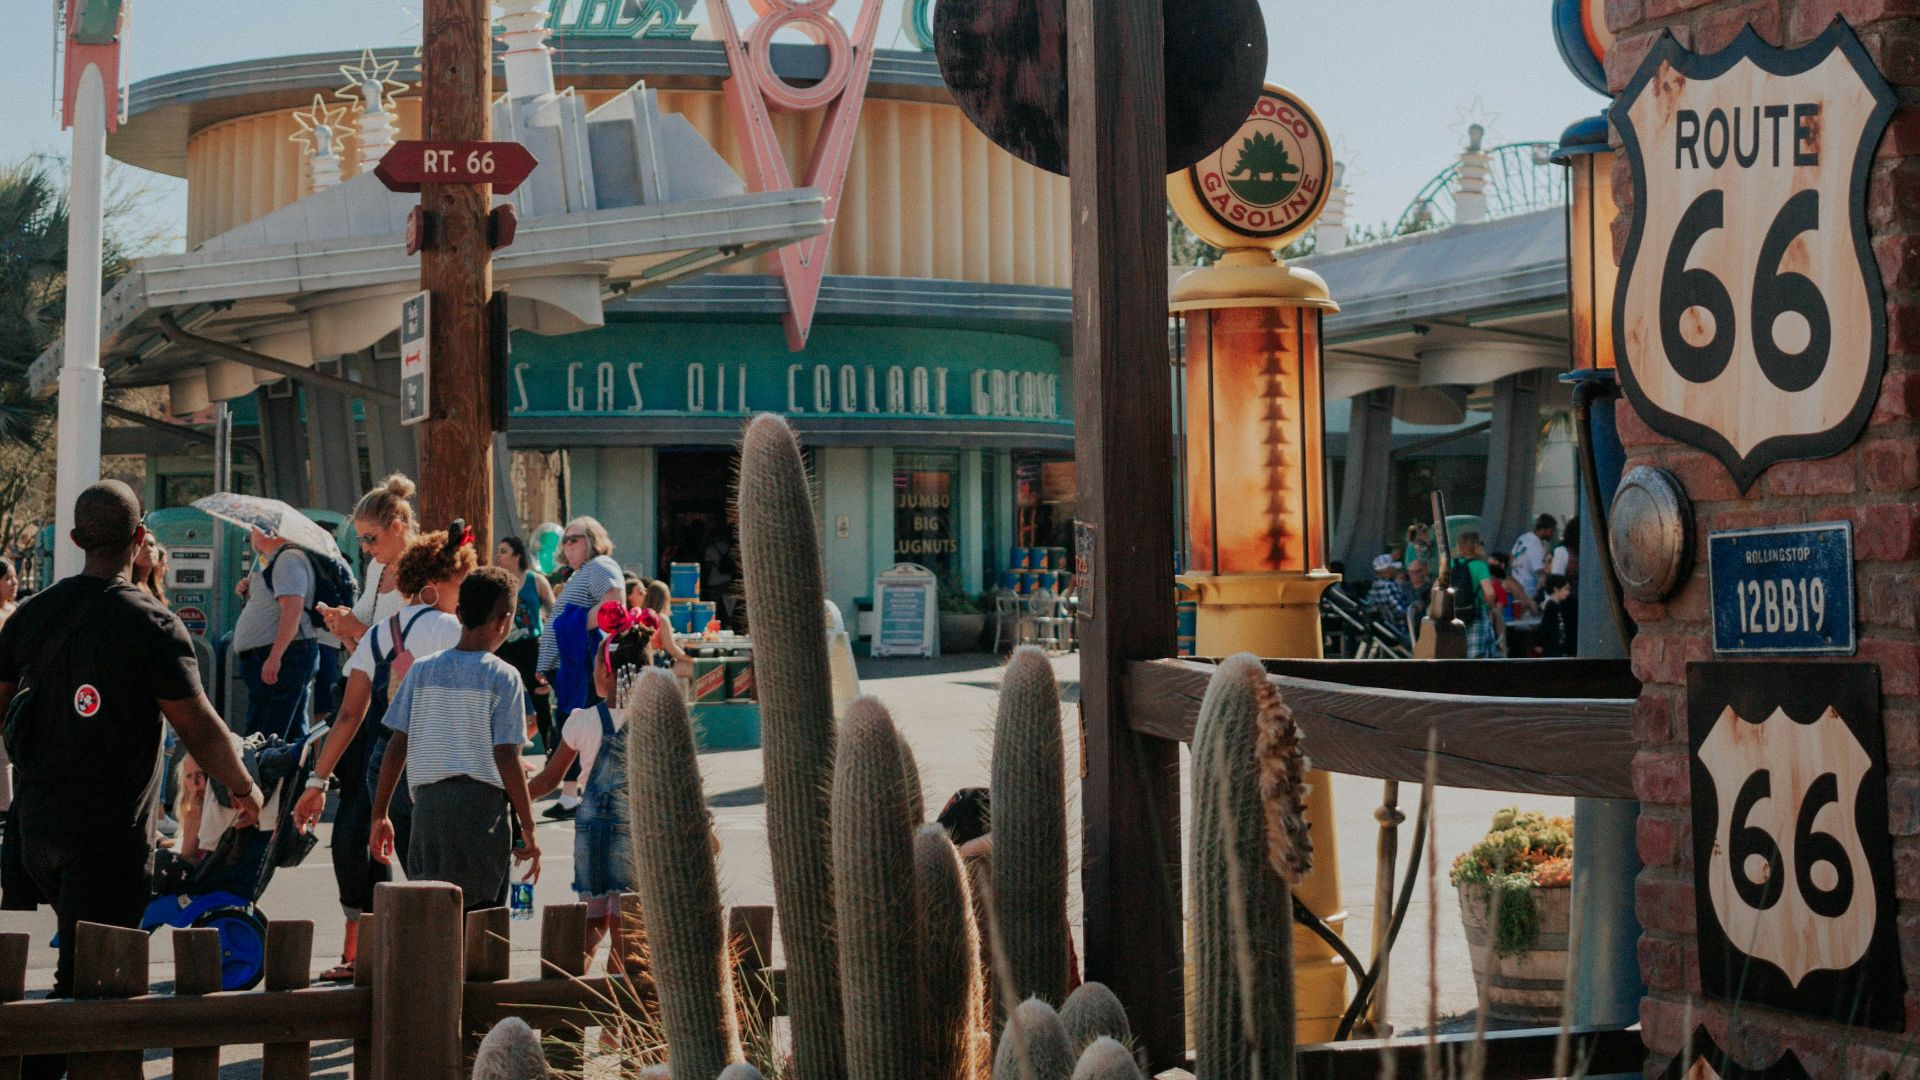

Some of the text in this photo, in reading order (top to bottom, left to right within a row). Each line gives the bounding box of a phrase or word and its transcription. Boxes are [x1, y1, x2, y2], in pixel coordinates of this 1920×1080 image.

[1251, 100, 1308, 138] OCO
[1675, 103, 1820, 169] ROUTE
[424, 150, 495, 174] RT. 66
[1204, 172, 1318, 227] GASOLINE
[1660, 189, 1831, 392] 66
[567, 362, 643, 412] GAS
[688, 363, 750, 413] OIL
[787, 364, 949, 416] COOLANT
[899, 495, 950, 508] JUMBO
[914, 517, 939, 531] BIG
[1745, 547, 1811, 564] ROLLINGSTOP
[1737, 577, 1825, 634] 12BB19
[1729, 768, 1854, 918] 66
